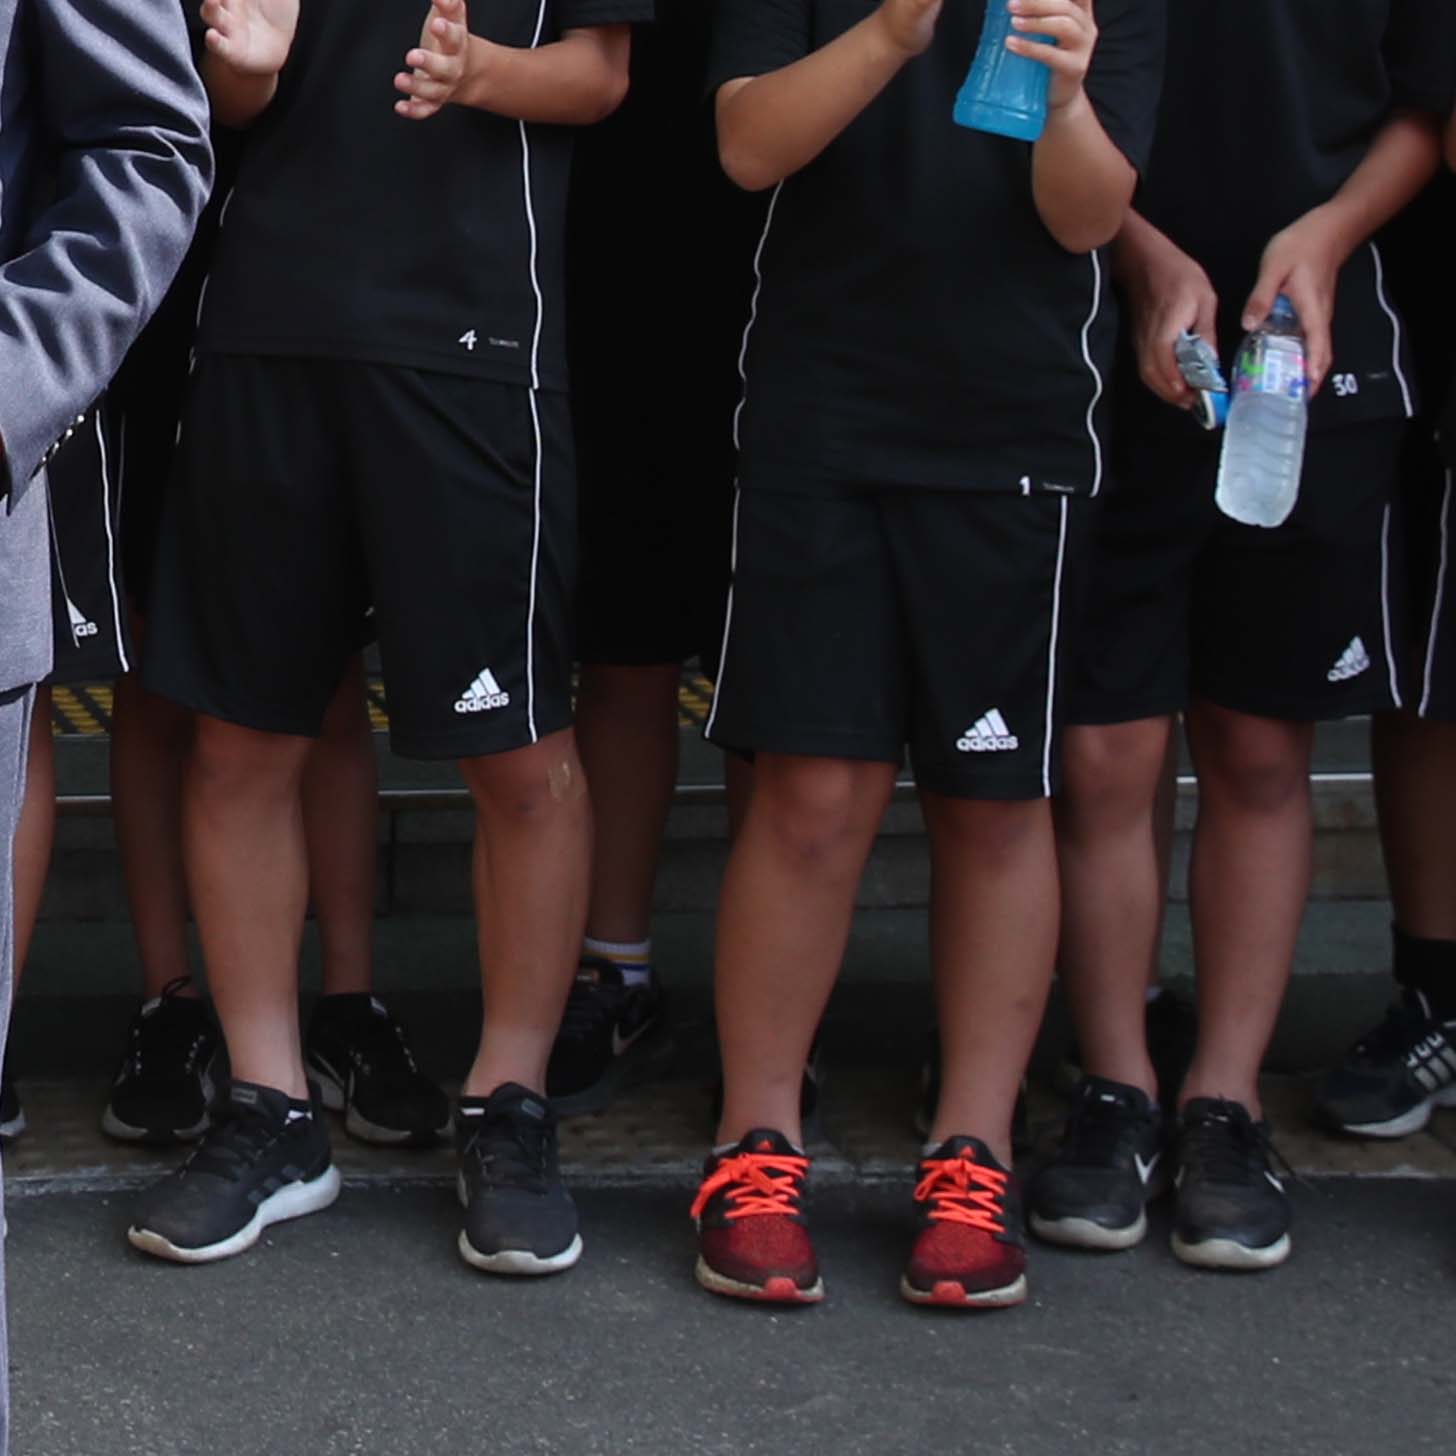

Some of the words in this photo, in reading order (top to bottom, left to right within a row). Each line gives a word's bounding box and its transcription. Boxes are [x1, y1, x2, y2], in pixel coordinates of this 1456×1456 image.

[457, 328, 478, 351] 4
[1018, 474, 1031, 497] 1
[453, 691, 510, 714] adidas
[955, 735, 1019, 753] adidas
